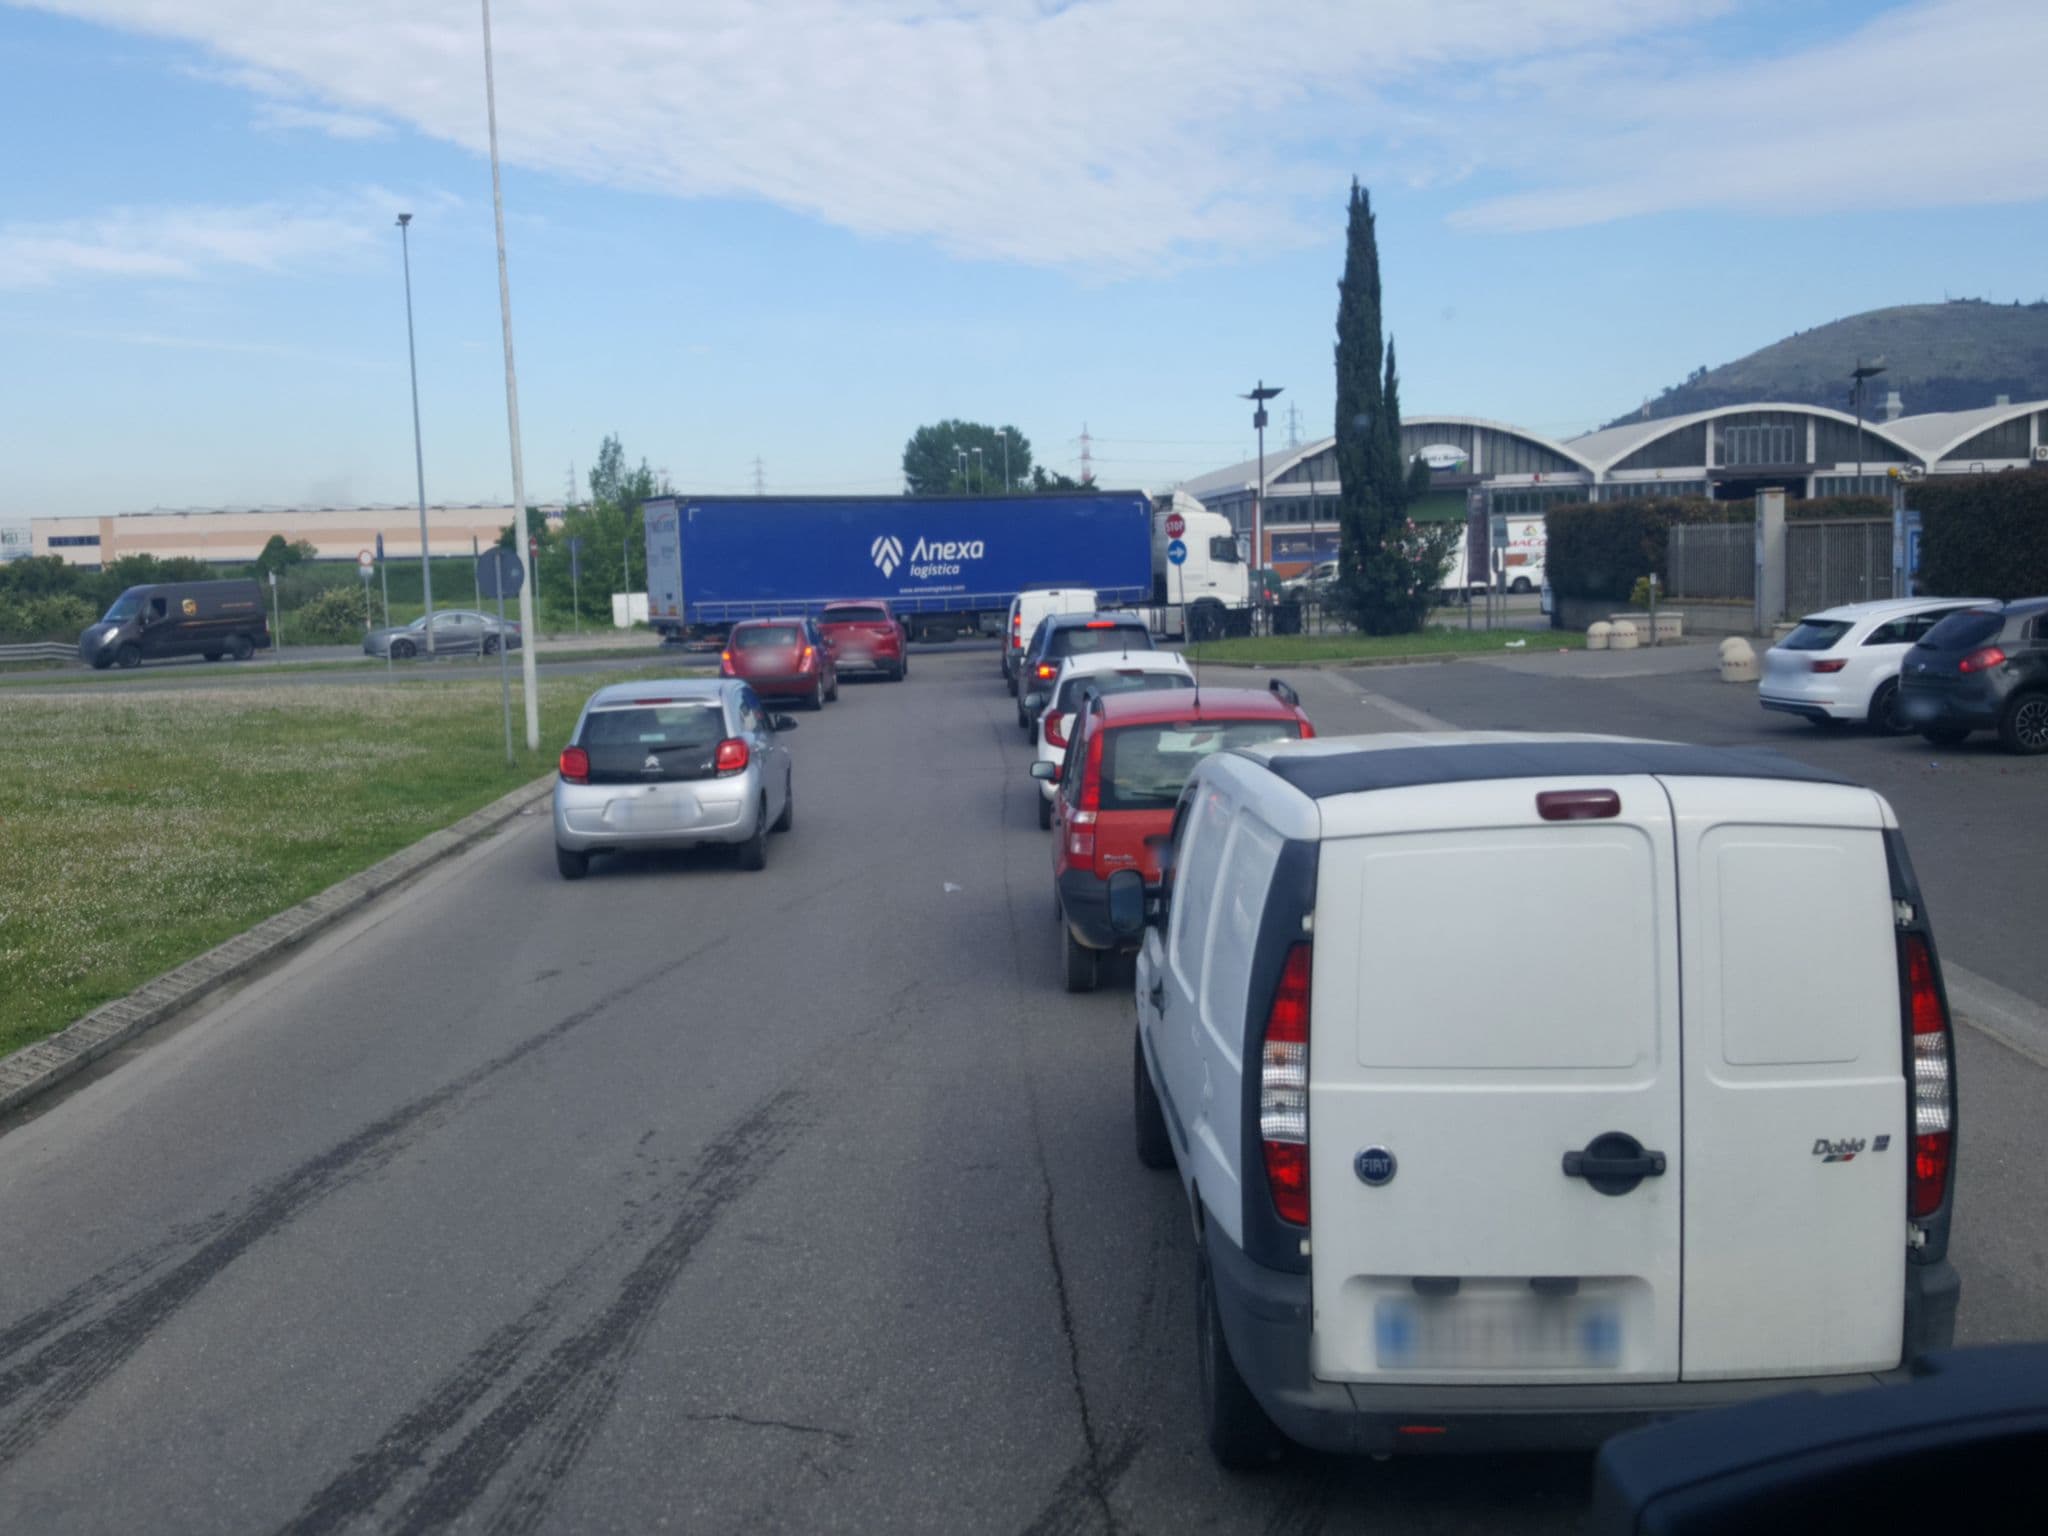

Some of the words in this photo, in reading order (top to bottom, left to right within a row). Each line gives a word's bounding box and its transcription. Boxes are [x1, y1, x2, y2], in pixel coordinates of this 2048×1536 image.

[1166, 520, 1183, 533] STOP
[910, 536, 984, 562] Anexa
[909, 563, 960, 579] logística
[1361, 1158, 1389, 1173] FIAT
